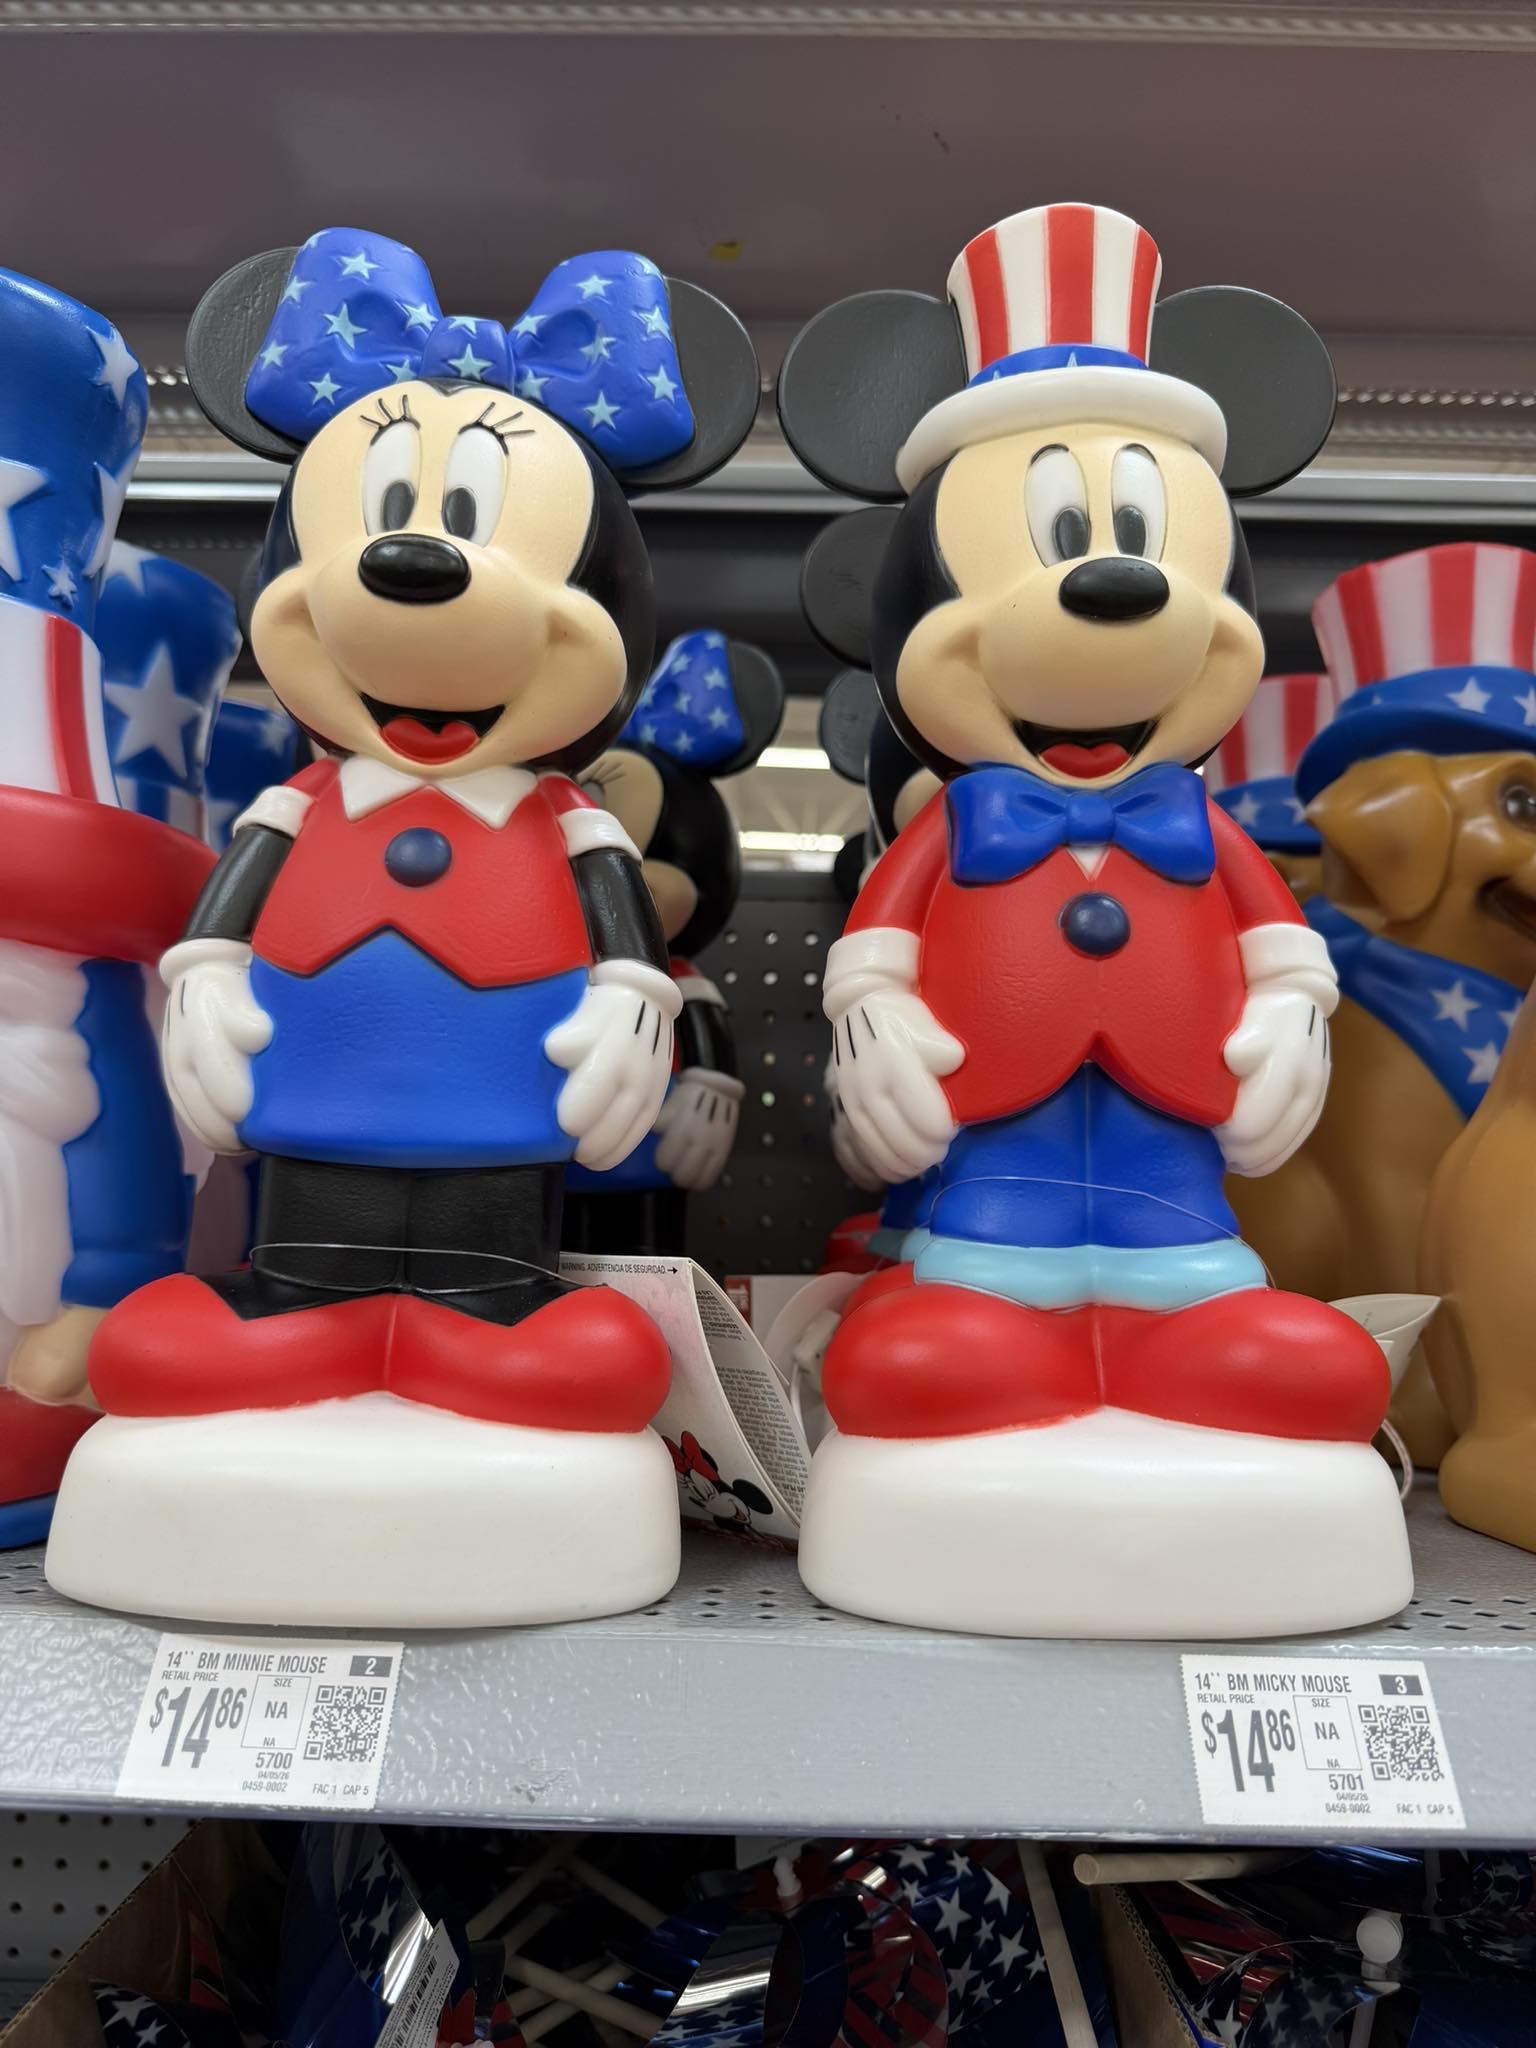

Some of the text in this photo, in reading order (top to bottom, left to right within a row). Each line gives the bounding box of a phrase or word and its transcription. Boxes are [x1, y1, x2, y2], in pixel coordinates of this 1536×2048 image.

[587, 1263, 624, 1273] ADVERTENCIA
[625, 1264, 633, 1273] DE
[197, 1653, 221, 1670] BM
[223, 1654, 274, 1672] MINNIE
[278, 1655, 327, 1673] MOUSE
[364, 1657, 376, 1675] 2
[161, 1670, 219, 1682] RETAIL PRICE
[273, 1678, 293, 1688] SIZE
[1227, 1674, 1249, 1691] BM
[1253, 1674, 1296, 1692] MICKY
[1302, 1675, 1352, 1693] MOUSE
[1394, 1676, 1408, 1694] 3
[1197, 1693, 1255, 1704] RETAIL PRICE
[1311, 1698, 1331, 1708] SIZE
[264, 1701, 288, 1719] NA
[1314, 1723, 1340, 1740] NA
[263, 1737, 276, 1747] NA
[255, 1752, 293, 1769] 5700
[1326, 1759, 1340, 1769] NA
[1328, 1774, 1365, 1791] 5701
[312, 1783, 330, 1795] FAC
[343, 1785, 361, 1796] CAP
[361, 1785, 370, 1796] 5
[1396, 1803, 1415, 1815] FAC
[1427, 1803, 1445, 1815] CAP
[1447, 1804, 1455, 1815] 5
